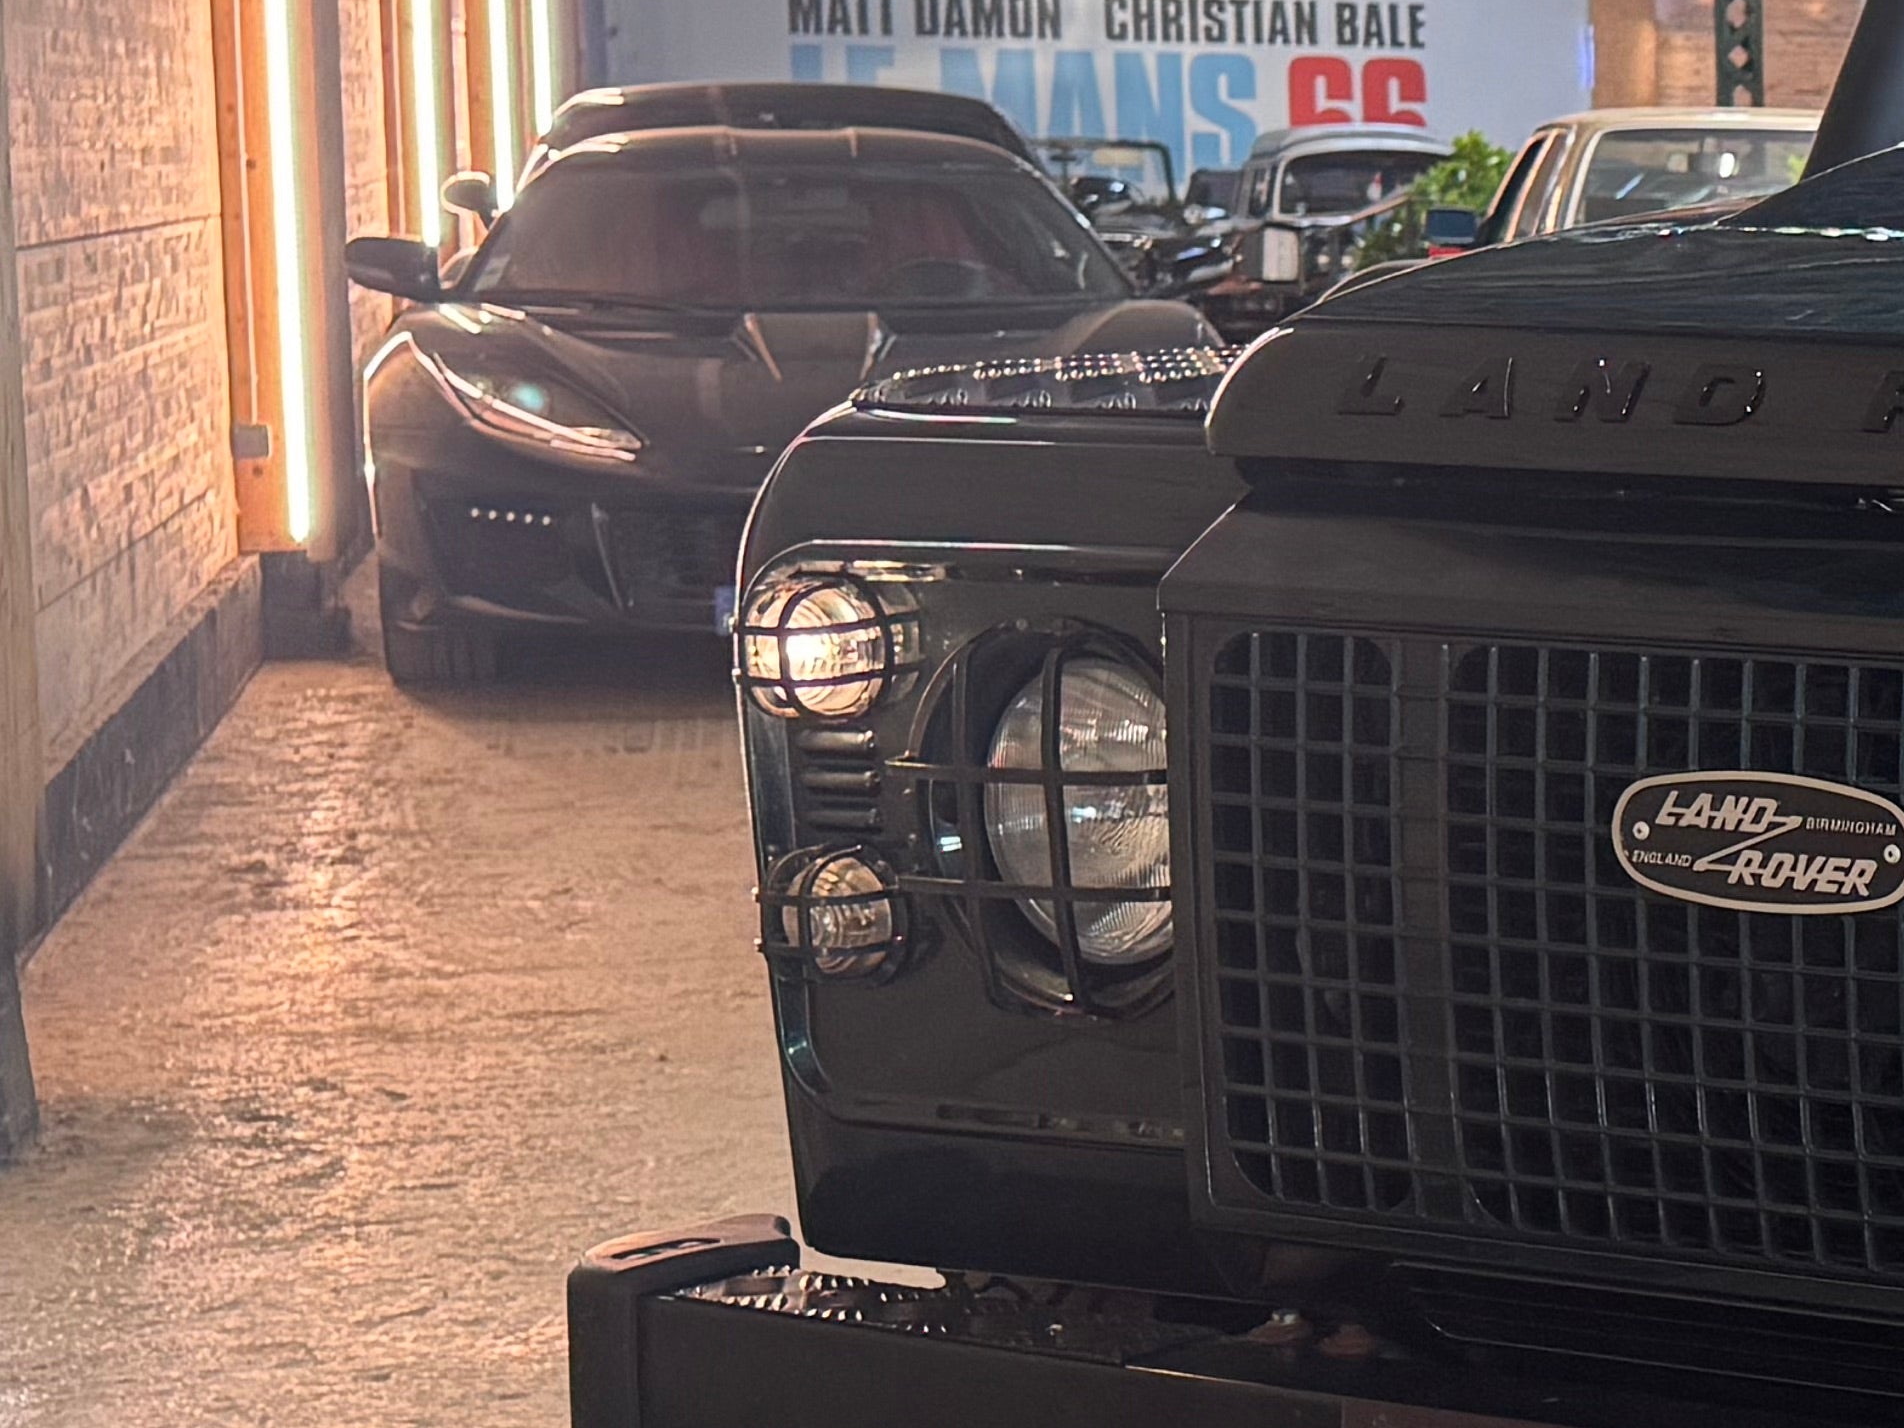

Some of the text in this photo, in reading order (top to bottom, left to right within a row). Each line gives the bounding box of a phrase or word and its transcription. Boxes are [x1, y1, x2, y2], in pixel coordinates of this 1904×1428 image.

[1336, 1, 1427, 49] BALE
[1335, 356, 1767, 428] LAND
[1655, 790, 1779, 833] LAND
[1805, 816, 1897, 836] BIRMINGHAM
[1631, 849, 1693, 868] ENGLAND
[1727, 849, 1878, 897] ROVER
